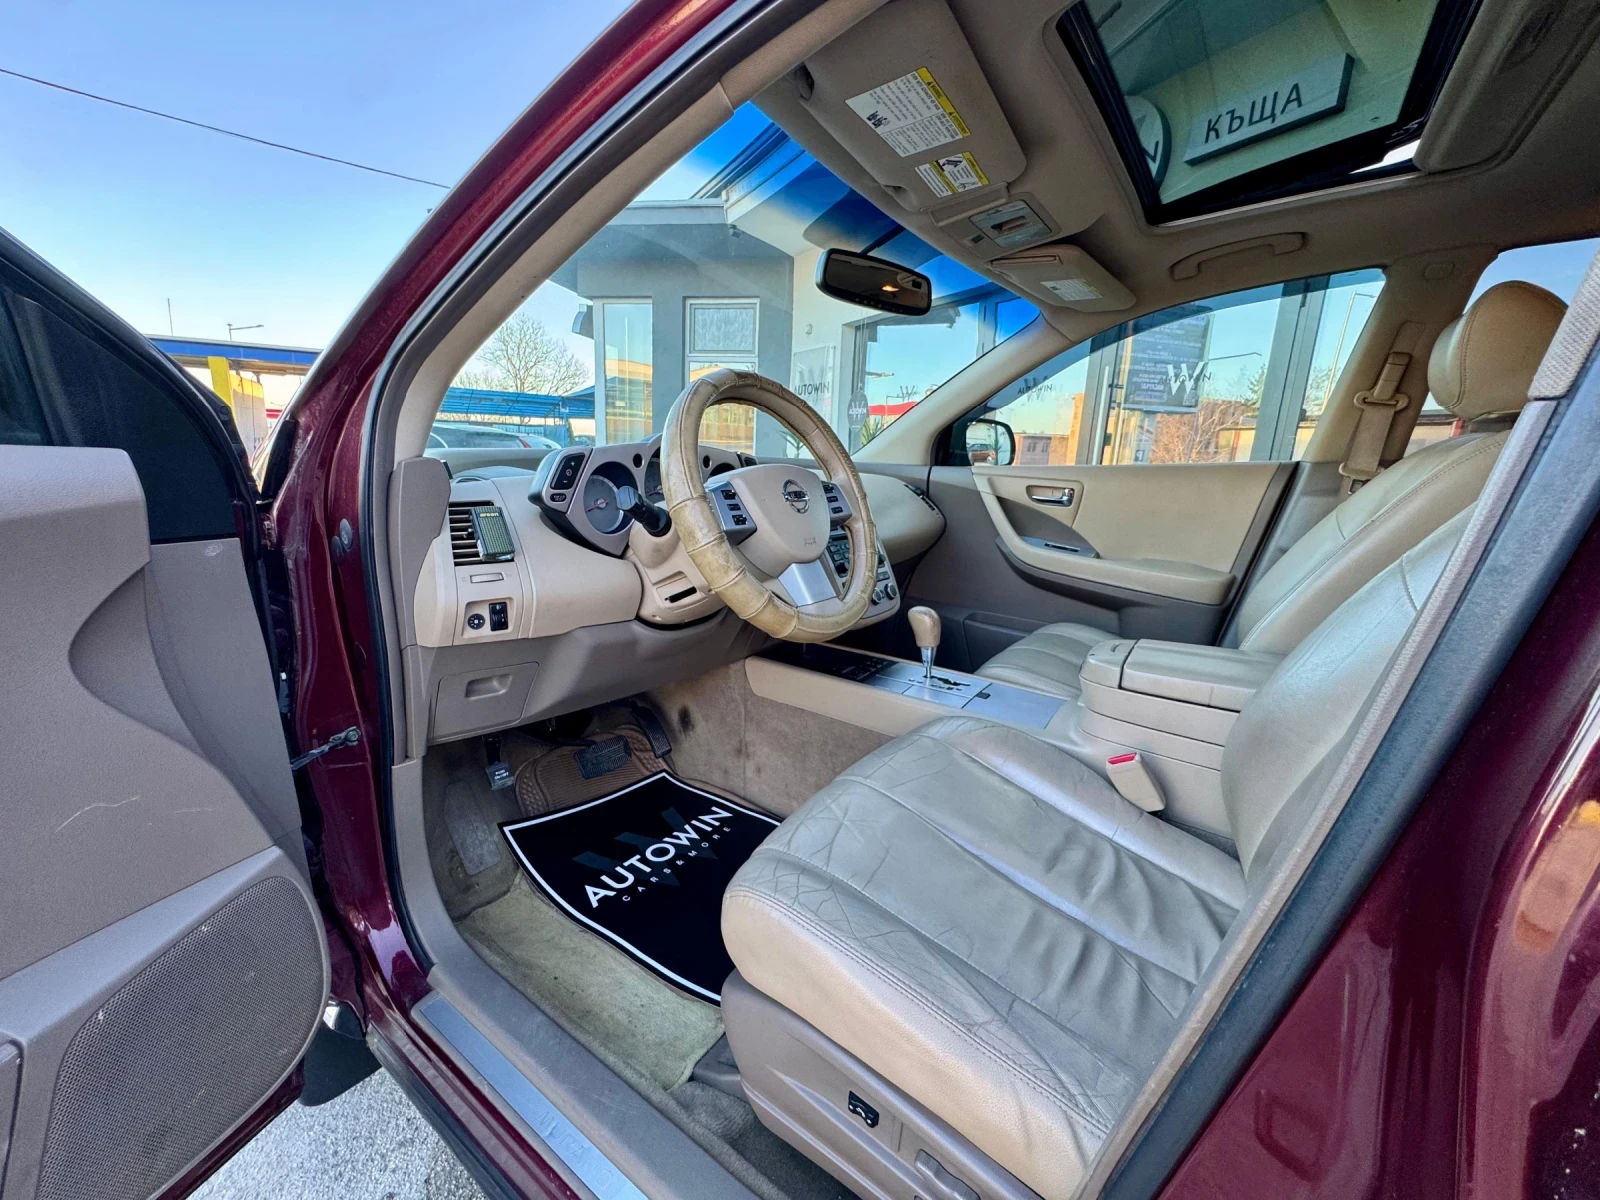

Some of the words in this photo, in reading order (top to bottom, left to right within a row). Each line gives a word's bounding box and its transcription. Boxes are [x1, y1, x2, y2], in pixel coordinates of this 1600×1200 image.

[1204, 82, 1303, 144] КЪЩА
[584, 806, 734, 909] AUTOWIN
[622, 868, 673, 902] CARS
[675, 859, 685, 867] &
[687, 826, 731, 858] MORE
